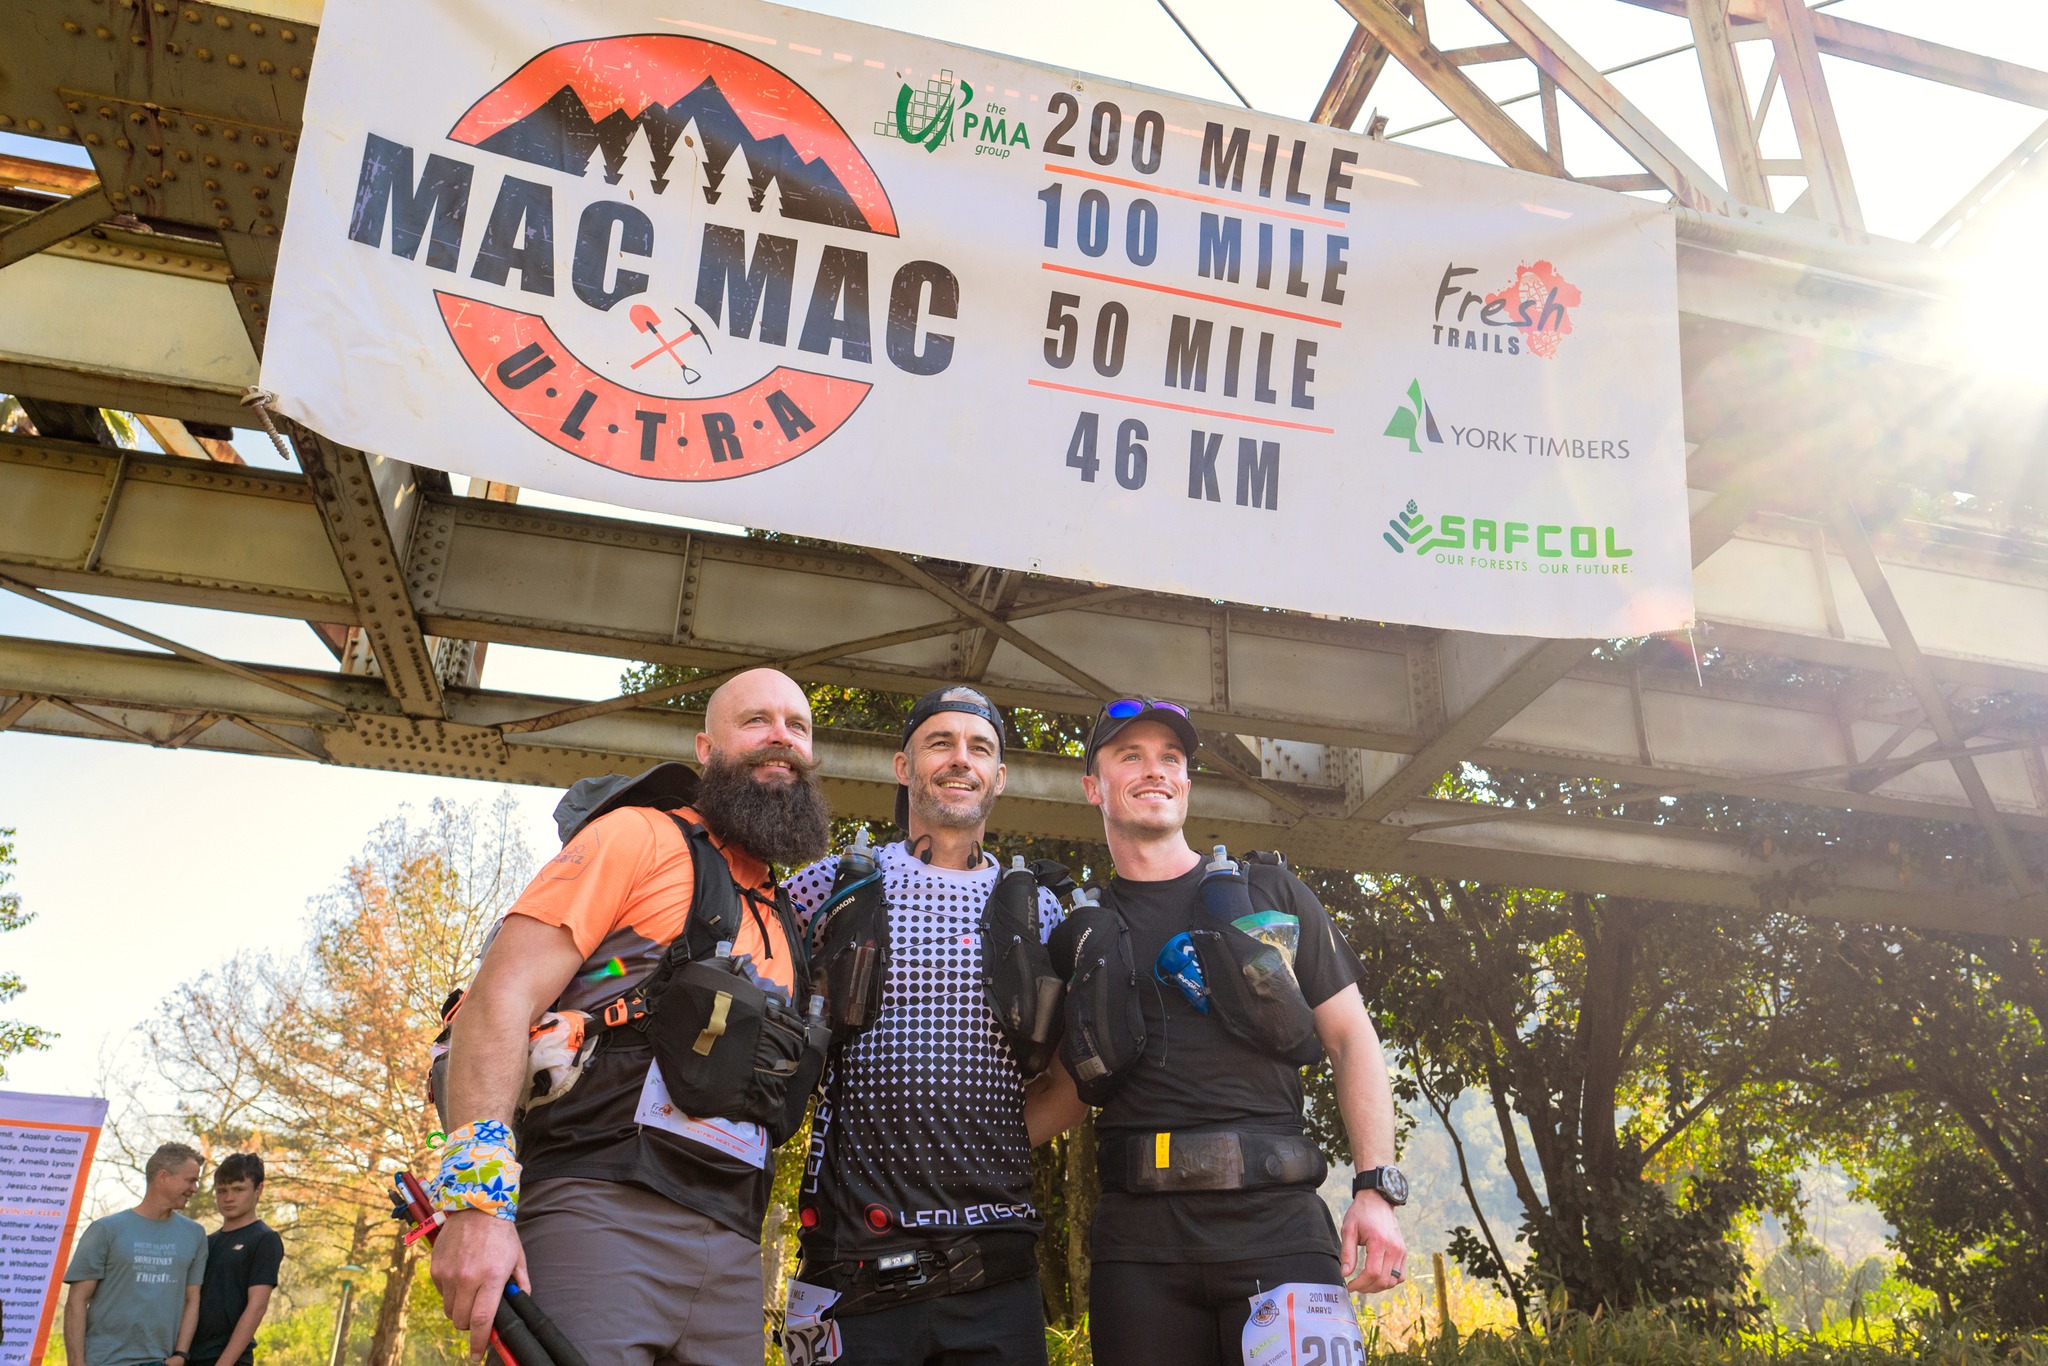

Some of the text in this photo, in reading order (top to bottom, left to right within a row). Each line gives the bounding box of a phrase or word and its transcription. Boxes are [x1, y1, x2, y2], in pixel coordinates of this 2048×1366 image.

[986, 102, 1006, 115] the
[963, 112, 1030, 149] PMA
[975, 144, 1010, 159] group
[1043, 91, 1359, 213] 200 MILE
[347, 131, 960, 377] MAC MAC
[1037, 181, 1350, 306] 100 MILE
[1434, 262, 1565, 332] Fresh
[1042, 290, 1318, 410] 50 MILE
[1432, 324, 1520, 356] TRAILS
[1450, 424, 1631, 460] YORK TIMBERS
[1065, 410, 1281, 511] 46 KM
[1434, 514, 1633, 558] SAFCOL
[1435, 553, 1464, 566] OUR
[1540, 563, 1569, 575] OUR
[1576, 563, 1633, 575] FUTURE.
[826, 896, 855, 924] ALOMON
[19, 1132, 51, 1141] Alastair
[55, 1135, 82, 1143] Cronin
[22, 1145, 47, 1153] David
[19, 1158, 49, 1166] Amelia
[52, 1160, 75, 1168] Lyons
[5, 1182, 37, 1190] Jessica
[9, 1260, 49, 1268] Whitehair
[1309, 1292, 1339, 1304] 200 MILE
